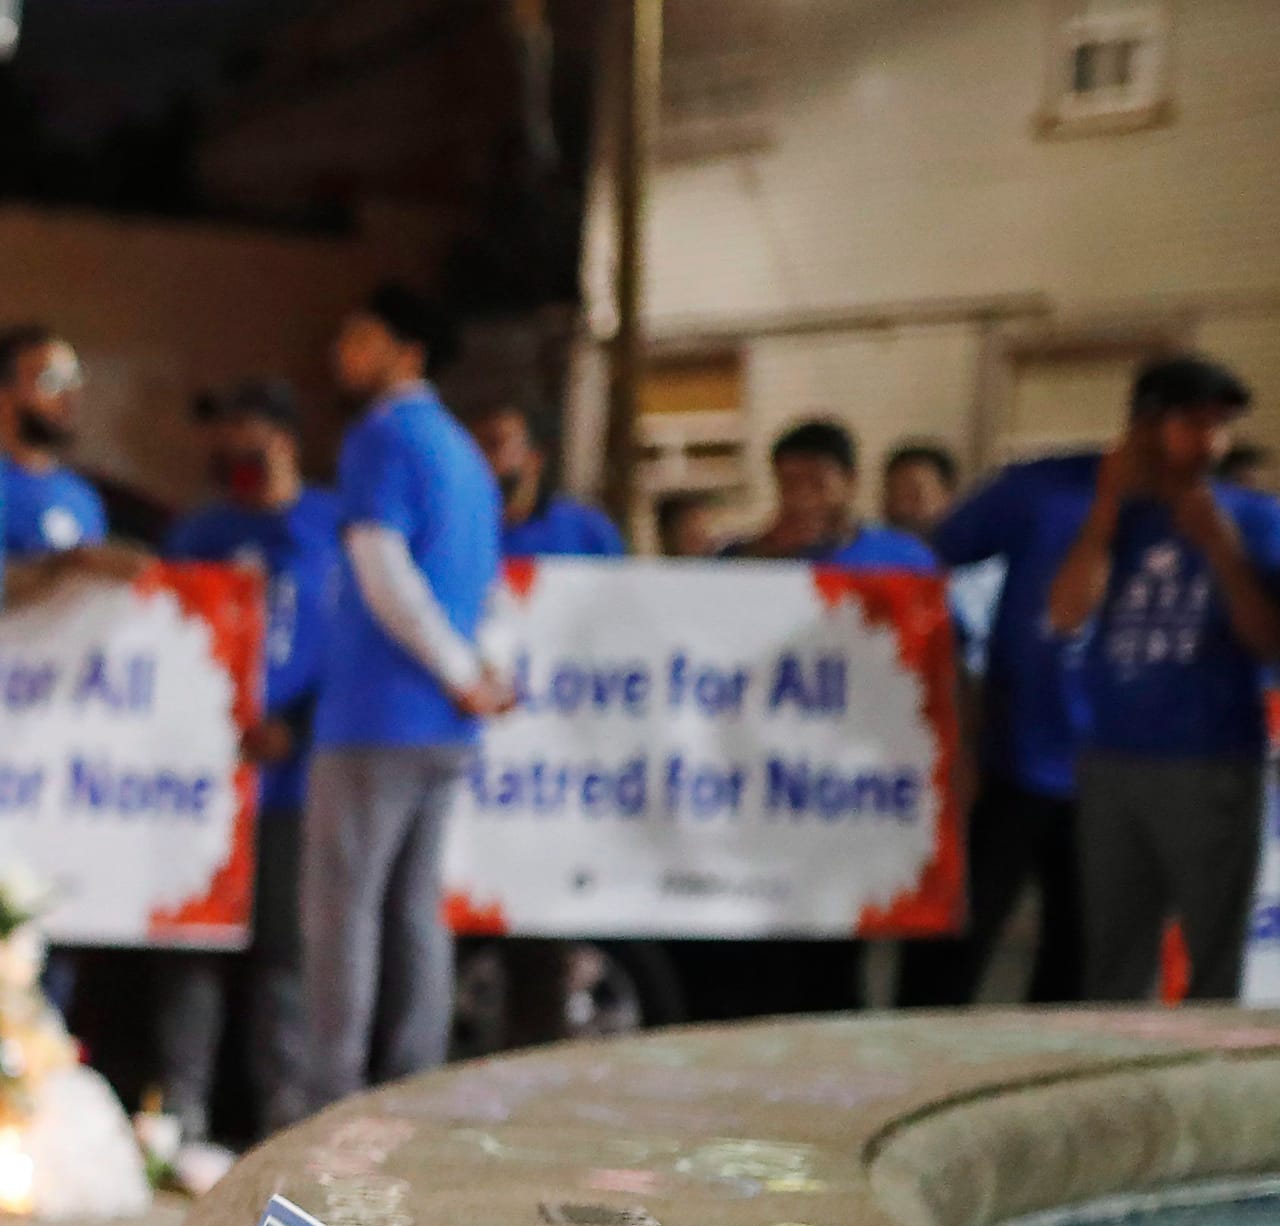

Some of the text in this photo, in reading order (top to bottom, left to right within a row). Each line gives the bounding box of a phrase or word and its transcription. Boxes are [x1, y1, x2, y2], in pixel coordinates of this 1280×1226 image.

[70, 648, 159, 712] All
[515, 648, 847, 716] Love for All
[67, 753, 214, 817] None
[666, 752, 747, 818] for
[765, 755, 922, 822] None
